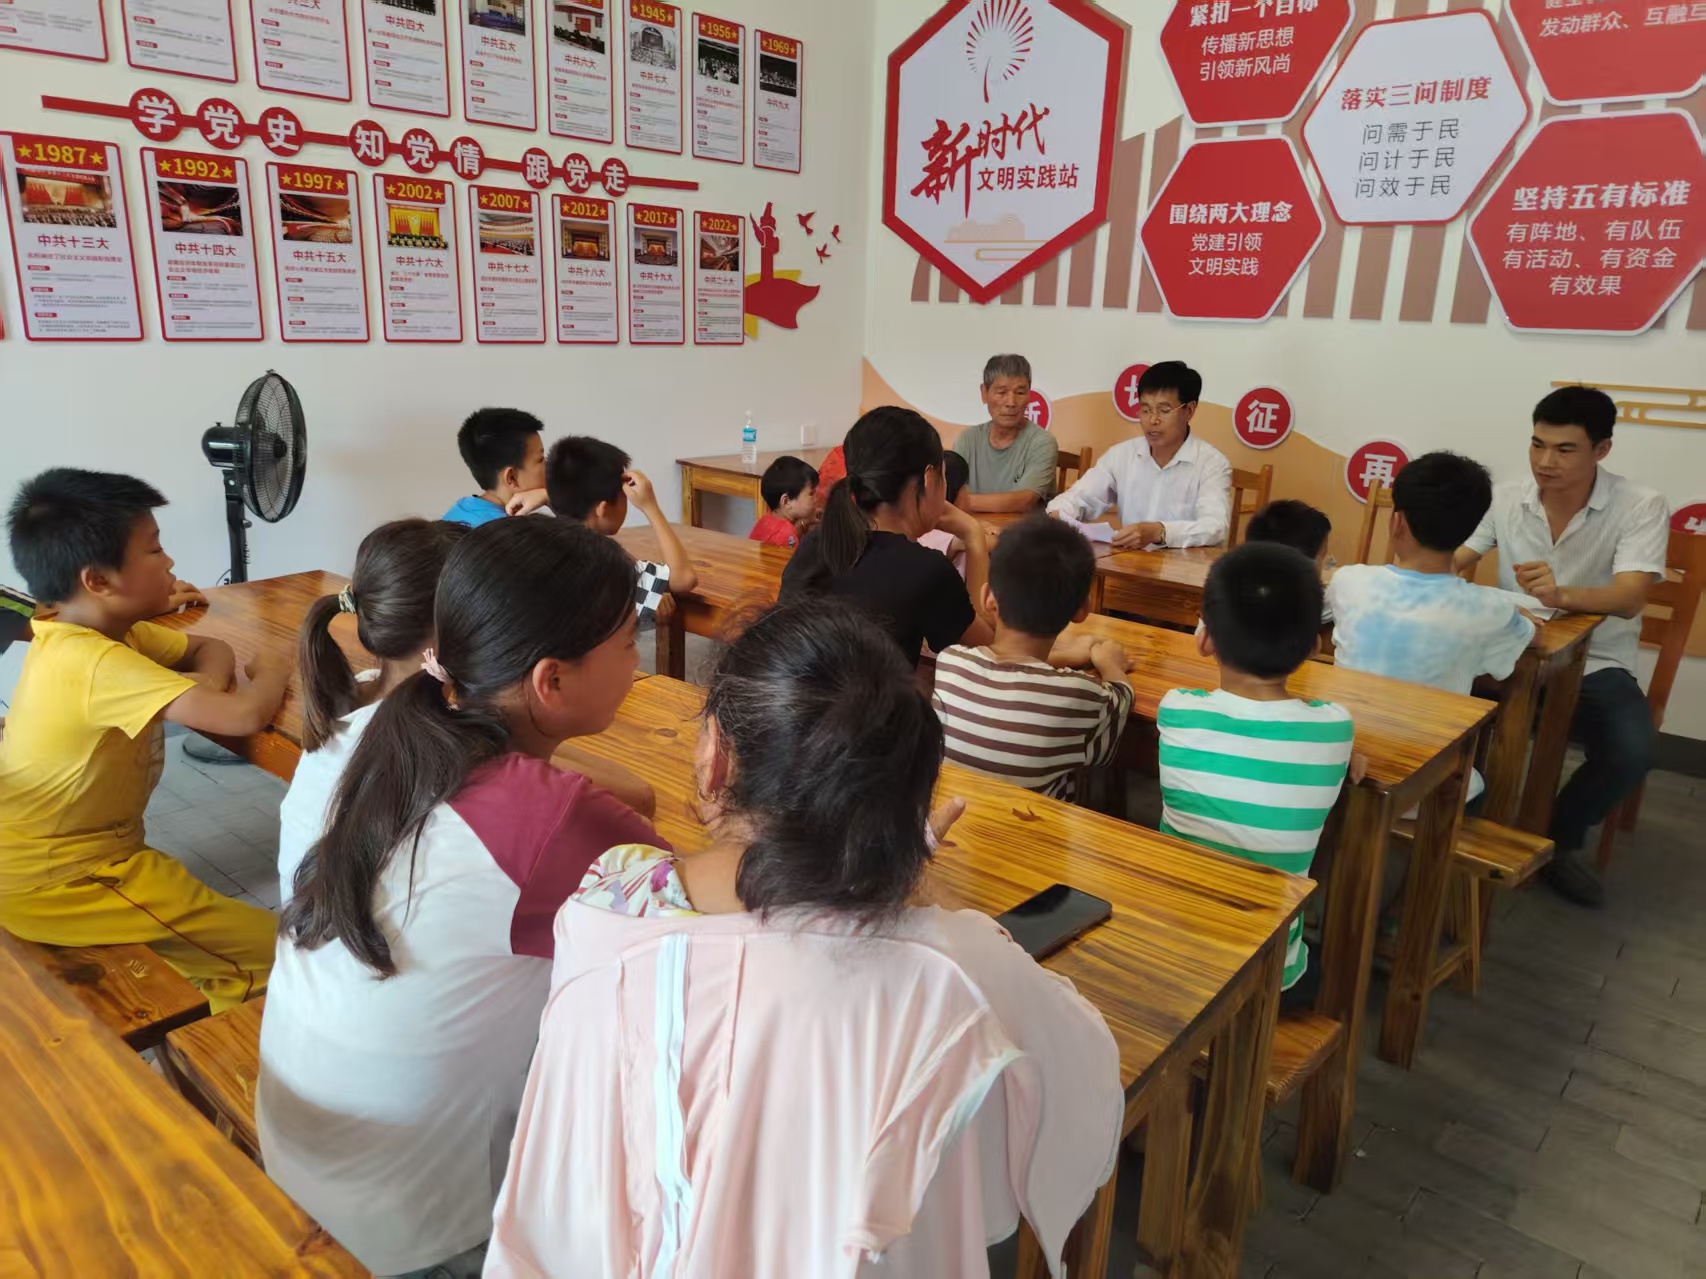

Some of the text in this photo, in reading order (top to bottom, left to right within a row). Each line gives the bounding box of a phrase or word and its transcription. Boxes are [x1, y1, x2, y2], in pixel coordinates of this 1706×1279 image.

[639, 2, 666, 23] 1945
[385, 14, 425, 33] 中共四大
[706, 21, 732, 40] 1956
[480, 35, 517, 52] 中共五大
[768, 37, 790, 54] 1969
[1200, 26, 1295, 56] 传播新思想
[563, 53, 598, 70] 中共六大
[1199, 53, 1291, 82] 引领新风尚
[639, 71, 669, 86] 中共七大
[1341, 76, 1491, 111] 落实三问制度
[1362, 117, 1460, 145] 问需于民
[35, 143, 86, 165] 1987
[911, 103, 1050, 219] 新时代
[1359, 147, 1455, 171] 问计于民
[174, 158, 220, 179] 1992
[976, 163, 1079, 192] 文明实践站
[293, 172, 333, 191] 1997
[397, 182, 433, 200] 2002
[1355, 174, 1451, 199] 问效于民
[488, 192, 521, 209] 2007
[1511, 180, 1691, 212] 坚持五有标准
[570, 201, 599, 217] 2012
[642, 209, 668, 225] 2017
[1168, 202, 1294, 226] 围绕两大理念
[708, 215, 733, 231] 2022
[37, 234, 110, 250] 中共十三大
[175, 241, 237, 257] 中共十四大
[1190, 232, 1263, 253] 党建引领
[292, 250, 347, 264] 中共十五大
[396, 255, 445, 269] 中共十六大
[487, 261, 530, 273] 中共十七大
[567, 266, 607, 278] 中共十八大
[639, 271, 674, 282] 中共十九大
[1188, 257, 1260, 277] 文明实践
[1549, 276, 1622, 297] 有效果
[1246, 399, 1280, 436] 征
